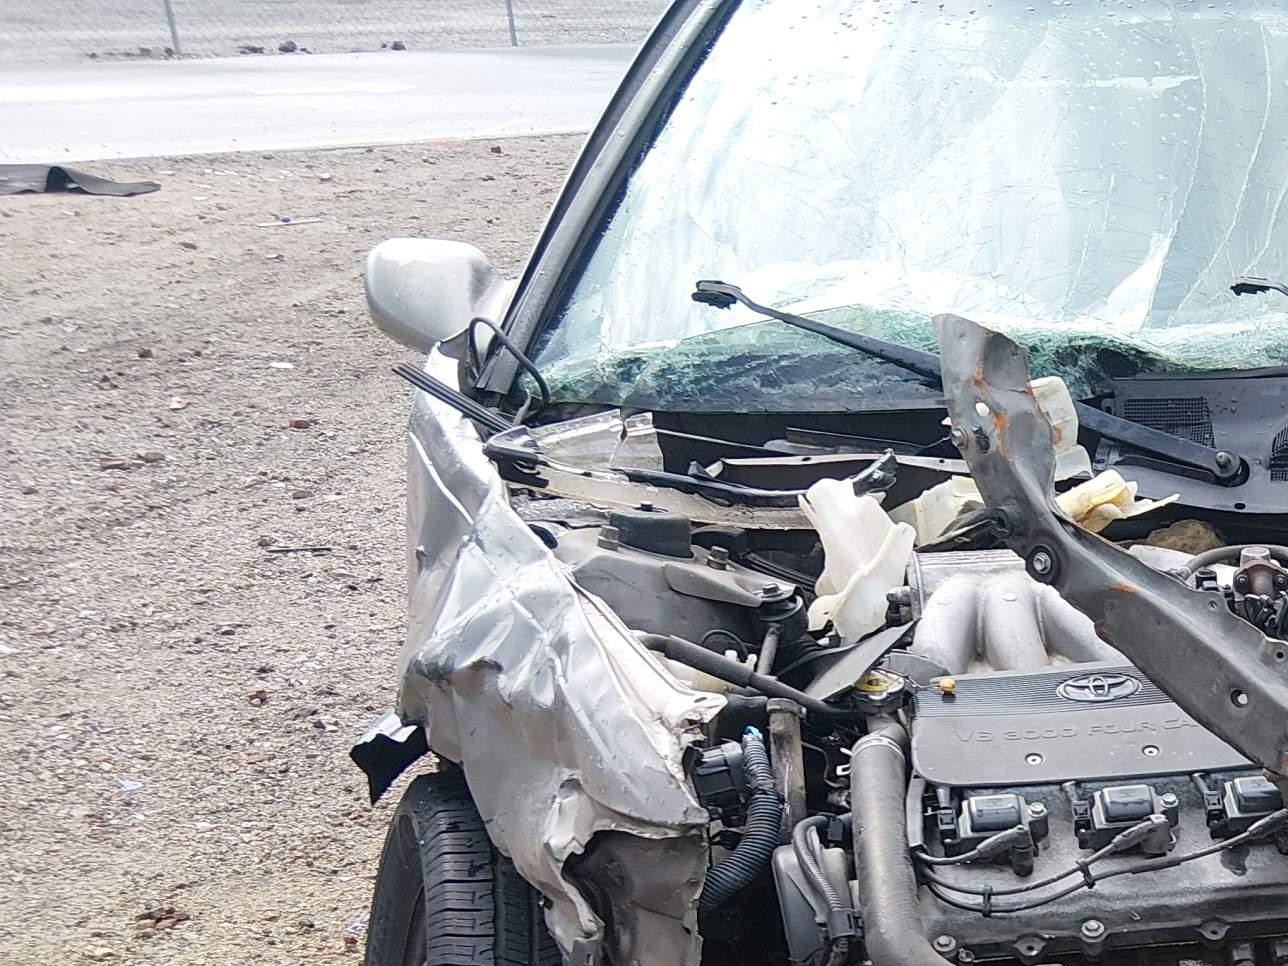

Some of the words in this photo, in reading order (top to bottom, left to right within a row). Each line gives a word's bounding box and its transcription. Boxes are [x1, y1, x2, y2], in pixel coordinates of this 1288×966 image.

[953, 729, 993, 743] V6
[1003, 727, 1078, 742] 3000
[1088, 721, 1156, 736] FOUR
[1163, 717, 1198, 730] CA
